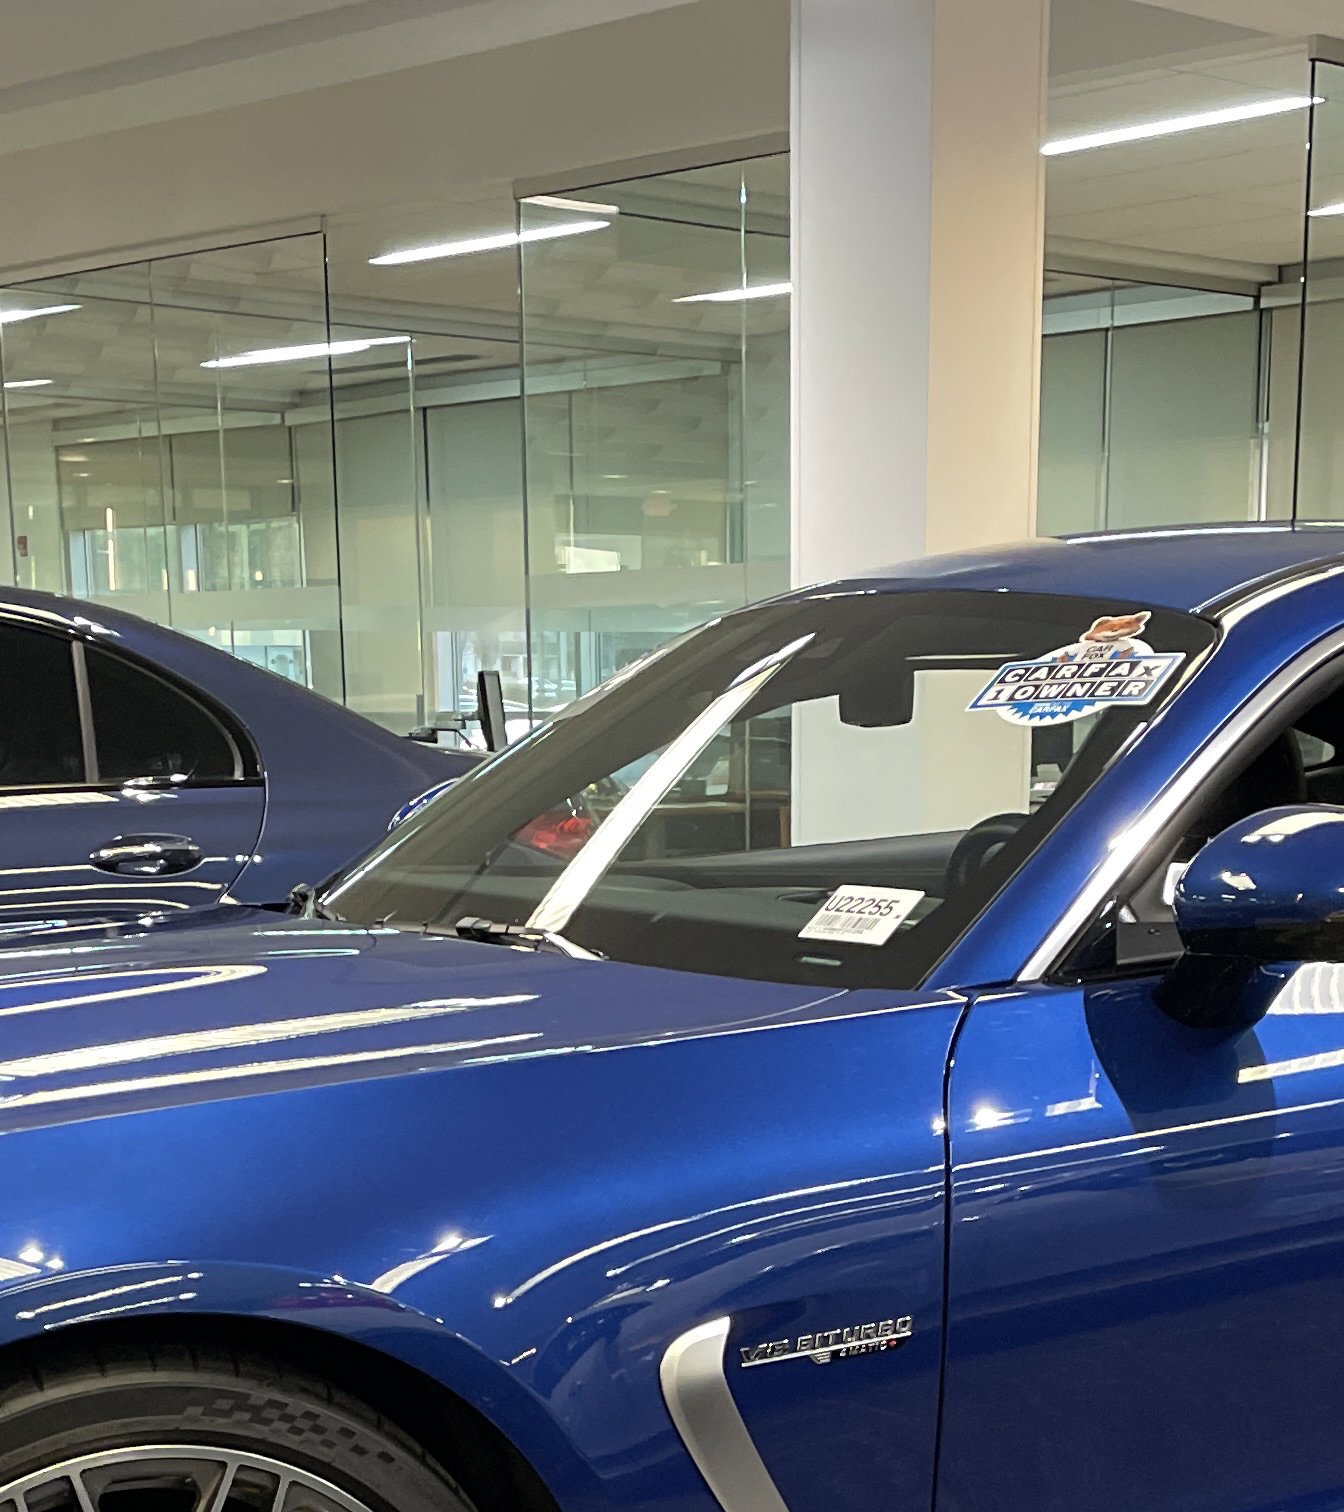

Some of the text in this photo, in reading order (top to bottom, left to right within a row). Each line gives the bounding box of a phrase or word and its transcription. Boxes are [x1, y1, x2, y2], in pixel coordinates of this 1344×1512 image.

[1081, 652, 1105, 660] FOX
[1086, 644, 1114, 652] CAR
[1003, 660, 1162, 683] CARFAX
[987, 681, 1147, 702] 1 OWNER
[796, 1315, 913, 1351] BITURBO
